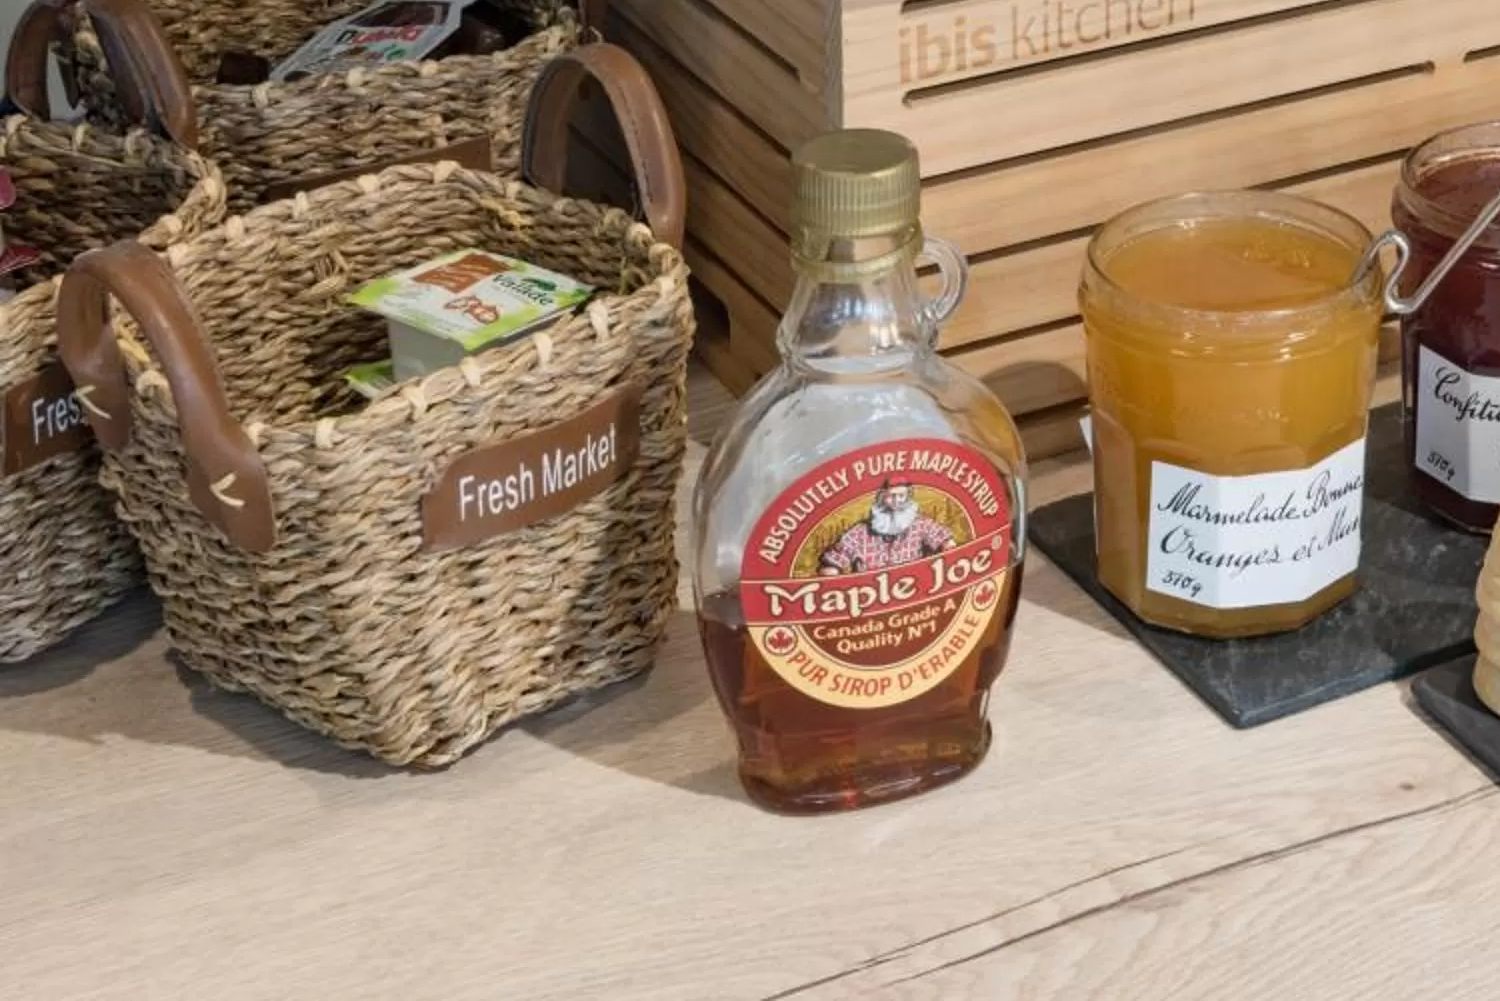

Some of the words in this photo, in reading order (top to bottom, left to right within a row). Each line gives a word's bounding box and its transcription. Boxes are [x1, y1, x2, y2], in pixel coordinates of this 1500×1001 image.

[898, 13, 998, 84] ibis
[32, 392, 88, 445] Fres
[458, 462, 535, 522] Fresh
[541, 423, 617, 496] Market
[760, 467, 849, 565] ABSOLUTELY
[853, 451, 907, 481] PURE
[910, 450, 967, 482] MAPLE
[961, 469, 999, 518] SYRUP
[1157, 482, 1302, 525] Marmelade
[1160, 524, 1283, 575] Oranges
[764, 572, 917, 617] Maple
[928, 550, 993, 594] Joe
[813, 619, 885, 640] Canada
[888, 605, 941, 627] Grade
[942, 598, 957, 614] A
[836, 631, 904, 655] Quality
[787, 651, 828, 686] PUR
[828, 672, 892, 697] SIROP
[899, 614, 980, 691] D'ERABLE
